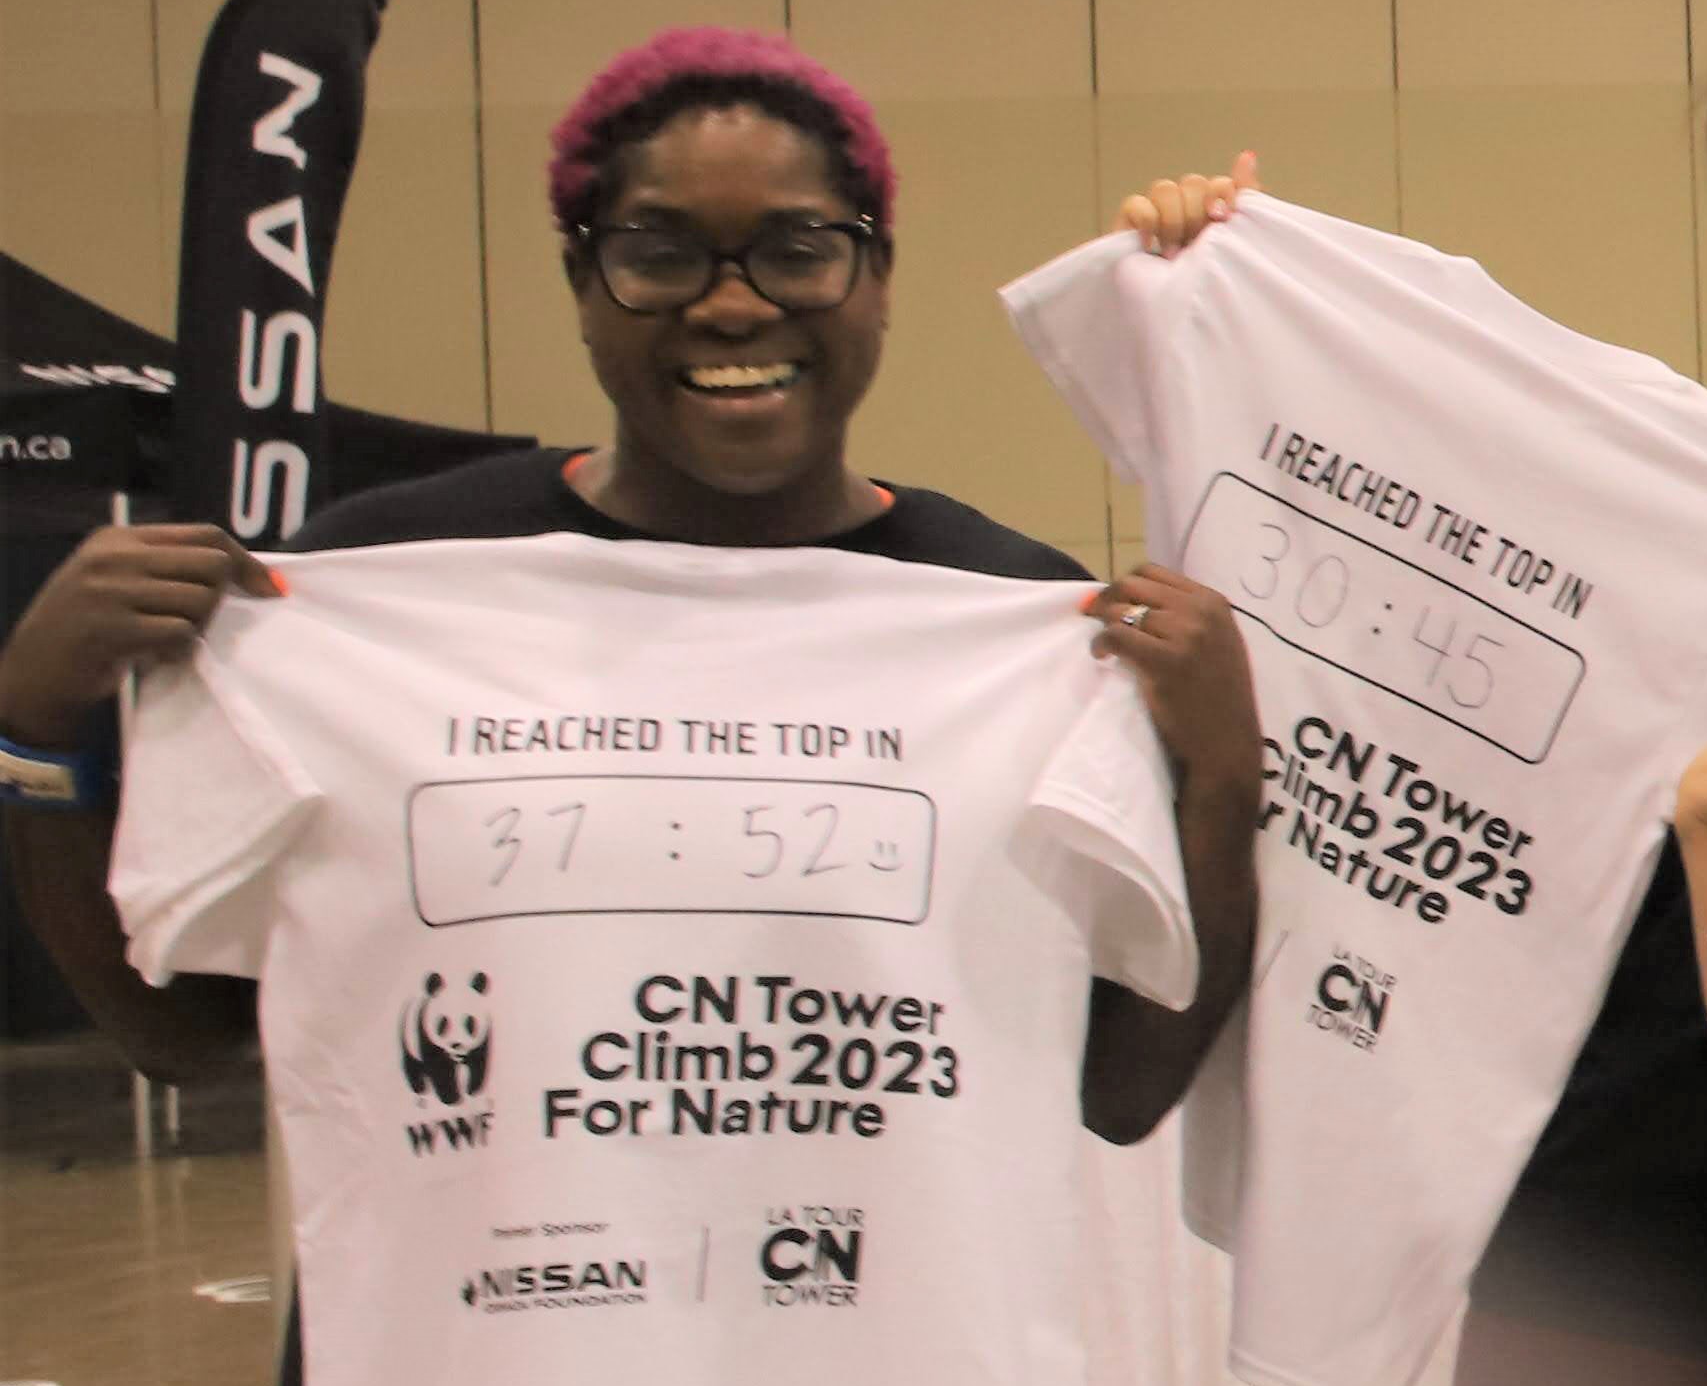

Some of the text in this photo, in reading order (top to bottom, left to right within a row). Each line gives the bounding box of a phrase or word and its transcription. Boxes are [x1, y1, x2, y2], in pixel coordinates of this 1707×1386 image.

[1258, 422, 1595, 620] I REACHED THE TOP IN
[446, 717, 903, 762] I REACHED THE TOP IN
[1294, 716, 1533, 859] CN Tower
[1260, 737, 1533, 916] Climb 2023
[1291, 809, 1451, 924] Nature
[636, 975, 946, 1034] CN Tower
[1318, 964, 1392, 1034] CN
[1305, 1004, 1378, 1055] TOWER
[581, 1031, 961, 1100] Climb 2023
[406, 1110, 495, 1158] WWF
[543, 1089, 887, 1139] For Nature
[767, 1206, 864, 1226] LA TOUR
[479, 1259, 648, 1299] NISSAN
[760, 1227, 863, 1282] CN
[761, 1283, 859, 1308] TOWER
